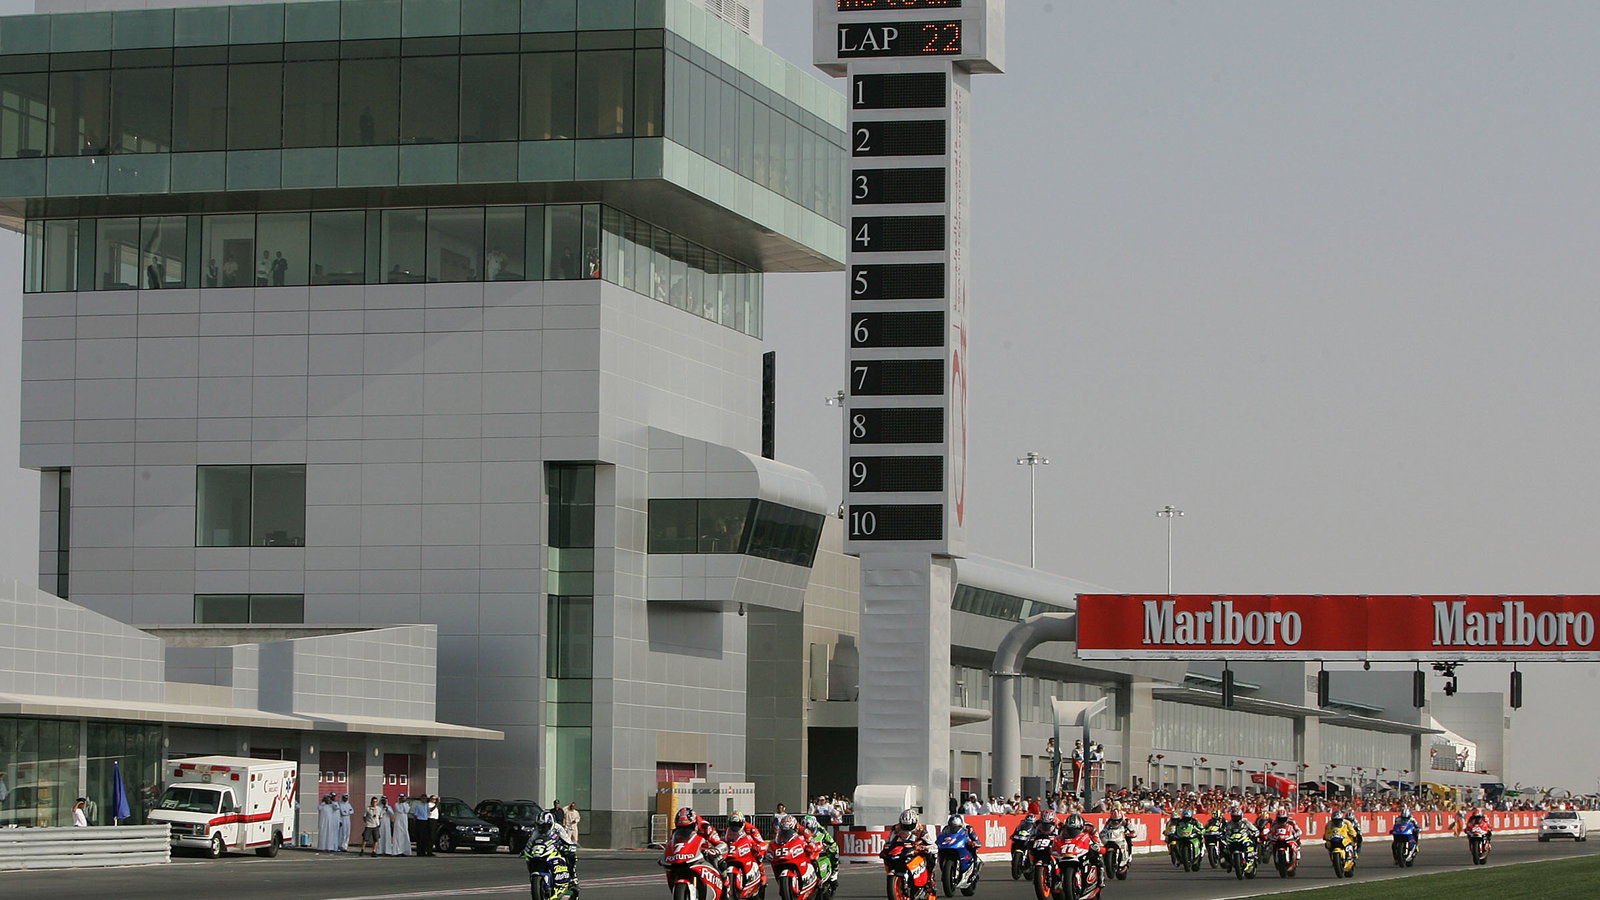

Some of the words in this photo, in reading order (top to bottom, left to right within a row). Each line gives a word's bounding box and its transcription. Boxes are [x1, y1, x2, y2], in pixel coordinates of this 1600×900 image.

[839, 27, 899, 52] LAP
[922, 23, 959, 52] 22
[857, 80, 865, 104] 1
[856, 128, 871, 151] 2
[855, 175, 869, 199] 3
[855, 223, 871, 246] 4
[854, 270, 868, 294] 5
[854, 318, 869, 343] 6
[854, 366, 868, 390] 7
[852, 414, 866, 438] 8
[852, 461, 867, 487] 9
[852, 511, 876, 535] 10
[1142, 599, 1302, 646] Marlboro
[1432, 600, 1595, 646] Marlboro
[775, 847, 789, 857] 65
[843, 833, 885, 854] Marlb
